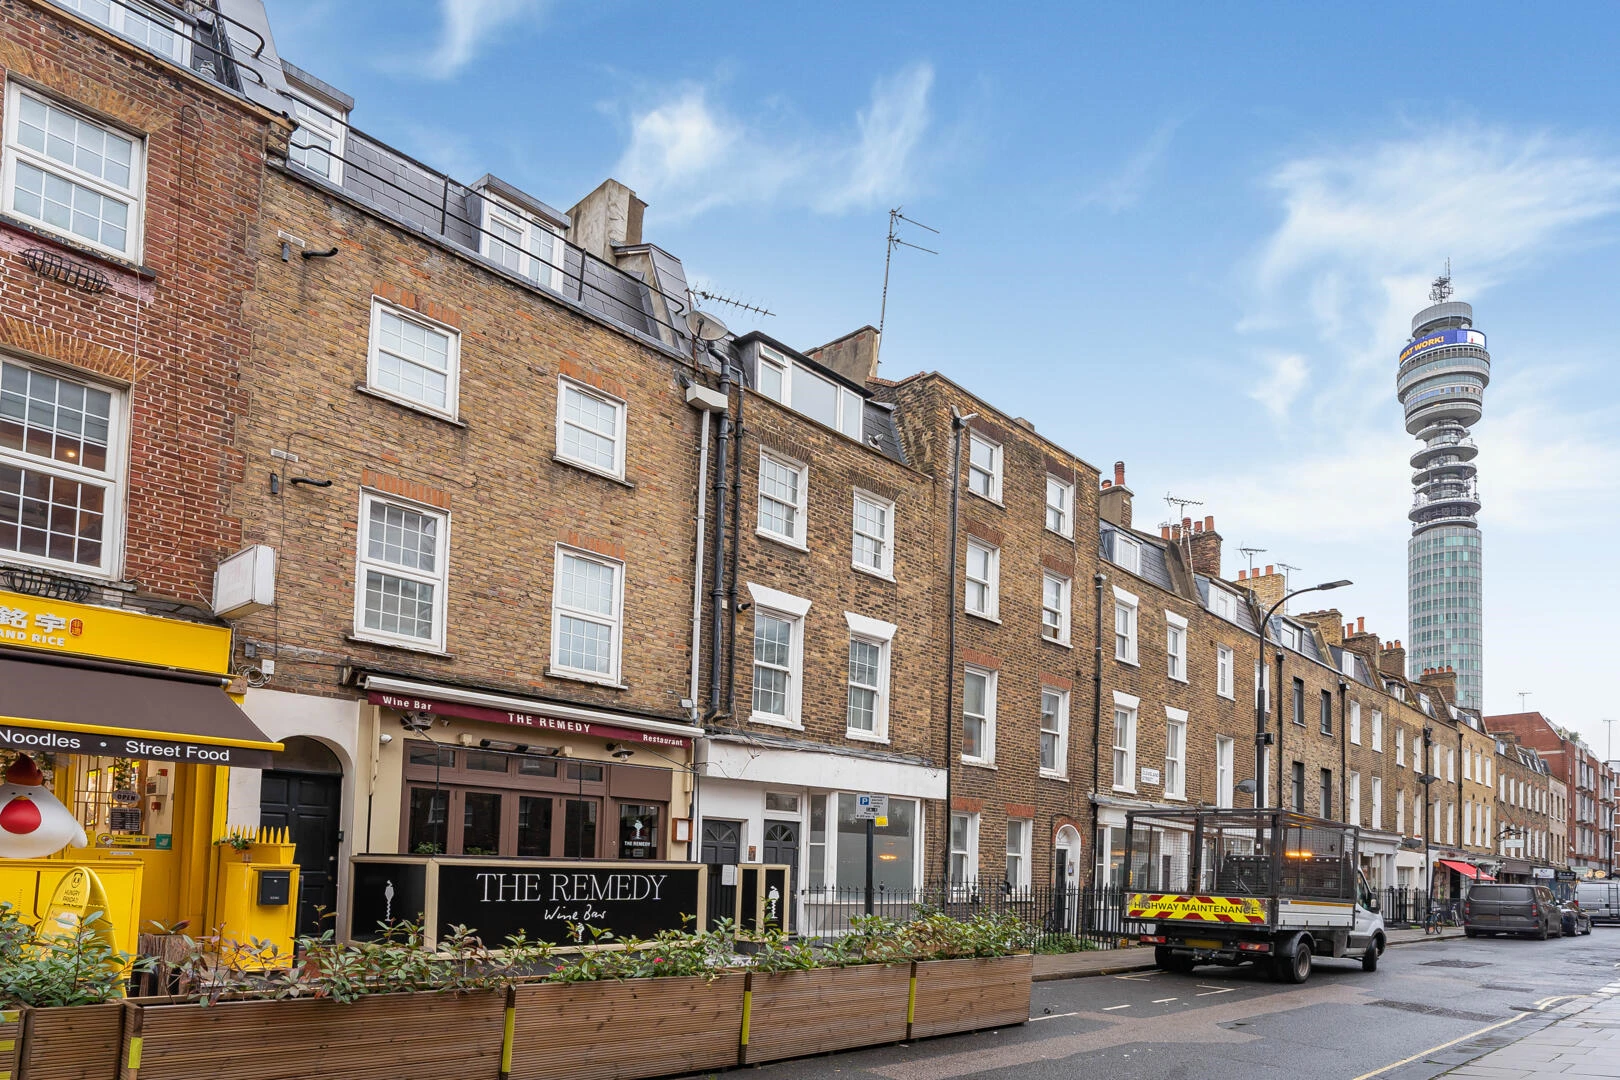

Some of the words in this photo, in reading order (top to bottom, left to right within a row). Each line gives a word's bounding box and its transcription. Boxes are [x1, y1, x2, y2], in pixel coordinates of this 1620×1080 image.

[1414, 336, 1444, 350] WORK!
[31, 633, 65, 647] RICE
[382, 695, 410, 707] Wine
[414, 701, 432, 711] Bar
[508, 712, 532, 725] THE
[539, 717, 591, 733] REMEDY
[0, 729, 81, 748] Noodles
[125, 740, 180, 758] Street
[186, 746, 230, 761] Food
[643, 733, 683, 746] Restaurant
[117, 793, 136, 801] OPEN
[476, 873, 541, 902] THE
[550, 874, 668, 901] REMEDY
[544, 905, 578, 921] Wine
[583, 904, 607, 921] Bar
[1134, 902, 1179, 911] HIGHWAY
[1182, 904, 1258, 915] MAINTENANCE
